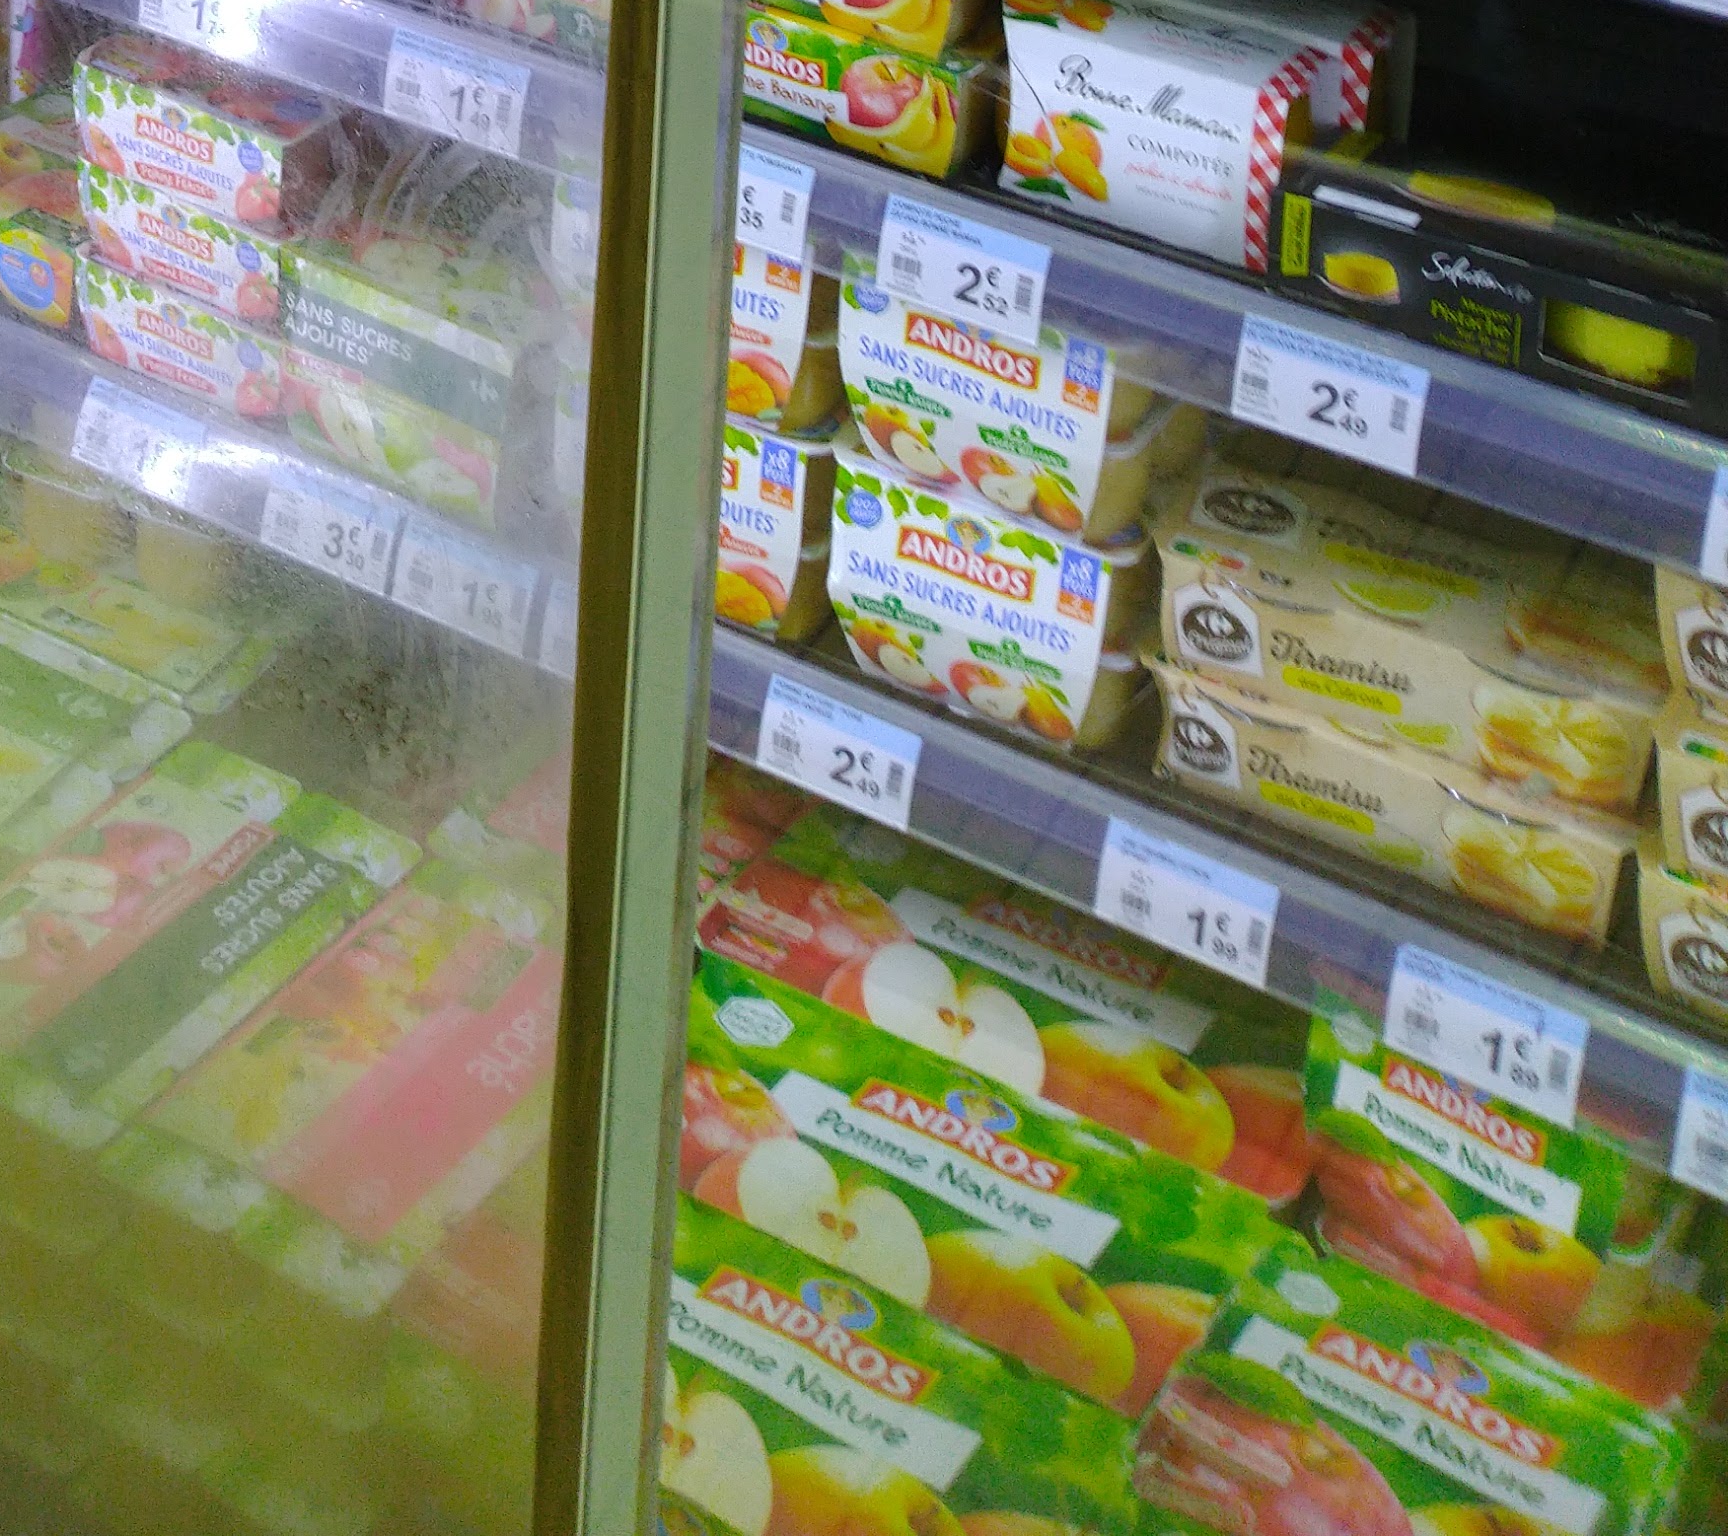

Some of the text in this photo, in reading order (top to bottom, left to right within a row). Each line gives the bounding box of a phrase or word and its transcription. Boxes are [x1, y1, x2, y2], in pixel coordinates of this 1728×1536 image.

[772, 83, 835, 115] Banane
[137, 117, 213, 163] ANDROS
[140, 216, 213, 259] ANDROS
[138, 312, 211, 358] ANDROS
[286, 292, 411, 361] SANS SUCRES
[908, 318, 1034, 386] ANDROS
[859, 334, 908, 371] SANS
[911, 357, 984, 405] SUCRES
[848, 549, 975, 617] SANS SUCRES
[902, 532, 1029, 598] ANDROS
[1271, 633, 1412, 693] Tiramisu
[1249, 745, 1384, 813] Tiramisu
[863, 1090, 1059, 1190] ANDROS
[1389, 1065, 1536, 1161] ANDROS
[816, 1108, 1053, 1232] Pomme Nature
[1365, 1091, 1547, 1206] Pomme Nature
[714, 1280, 919, 1401] ANDROS
[785, 1367, 909, 1447] Nature
[1320, 1336, 1545, 1462] ANDROS
